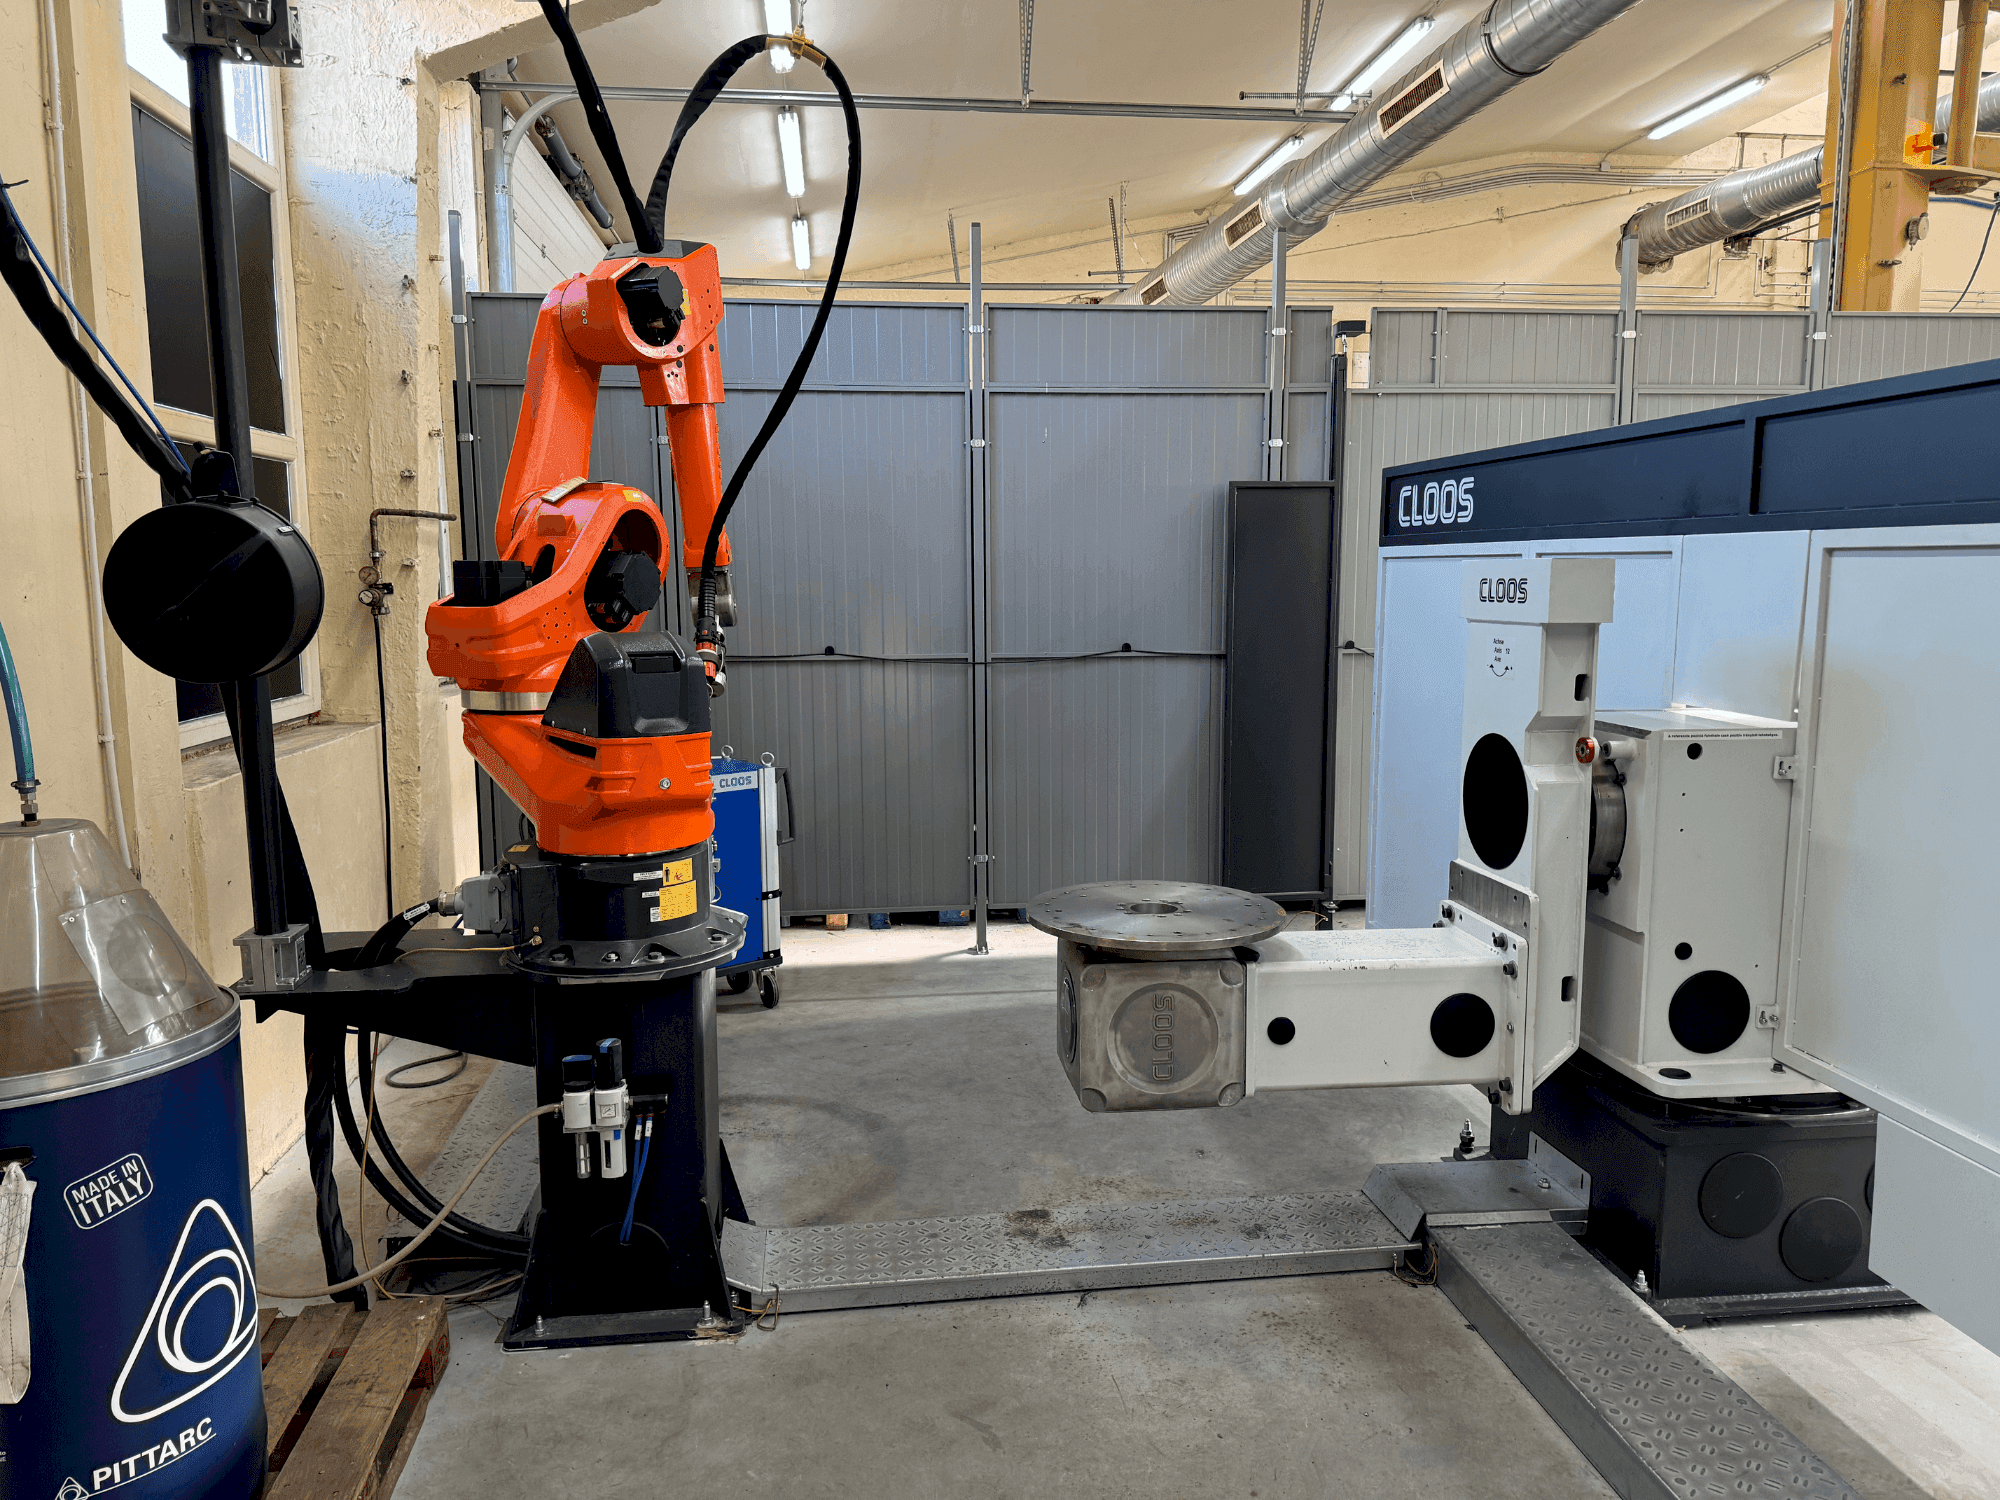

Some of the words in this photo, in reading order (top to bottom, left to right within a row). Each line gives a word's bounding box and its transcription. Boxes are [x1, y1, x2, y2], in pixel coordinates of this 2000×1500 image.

[1399, 476, 1475, 527] CLOOS
[1479, 577, 1528, 604] CLOOS
[719, 775, 752, 789] CLOOS
[1153, 993, 1174, 1081] CLOOS
[71, 1169, 120, 1204] MADE
[120, 1158, 139, 1178] IN
[78, 1171, 144, 1225] ITALY
[92, 1417, 213, 1491] PITTARC
